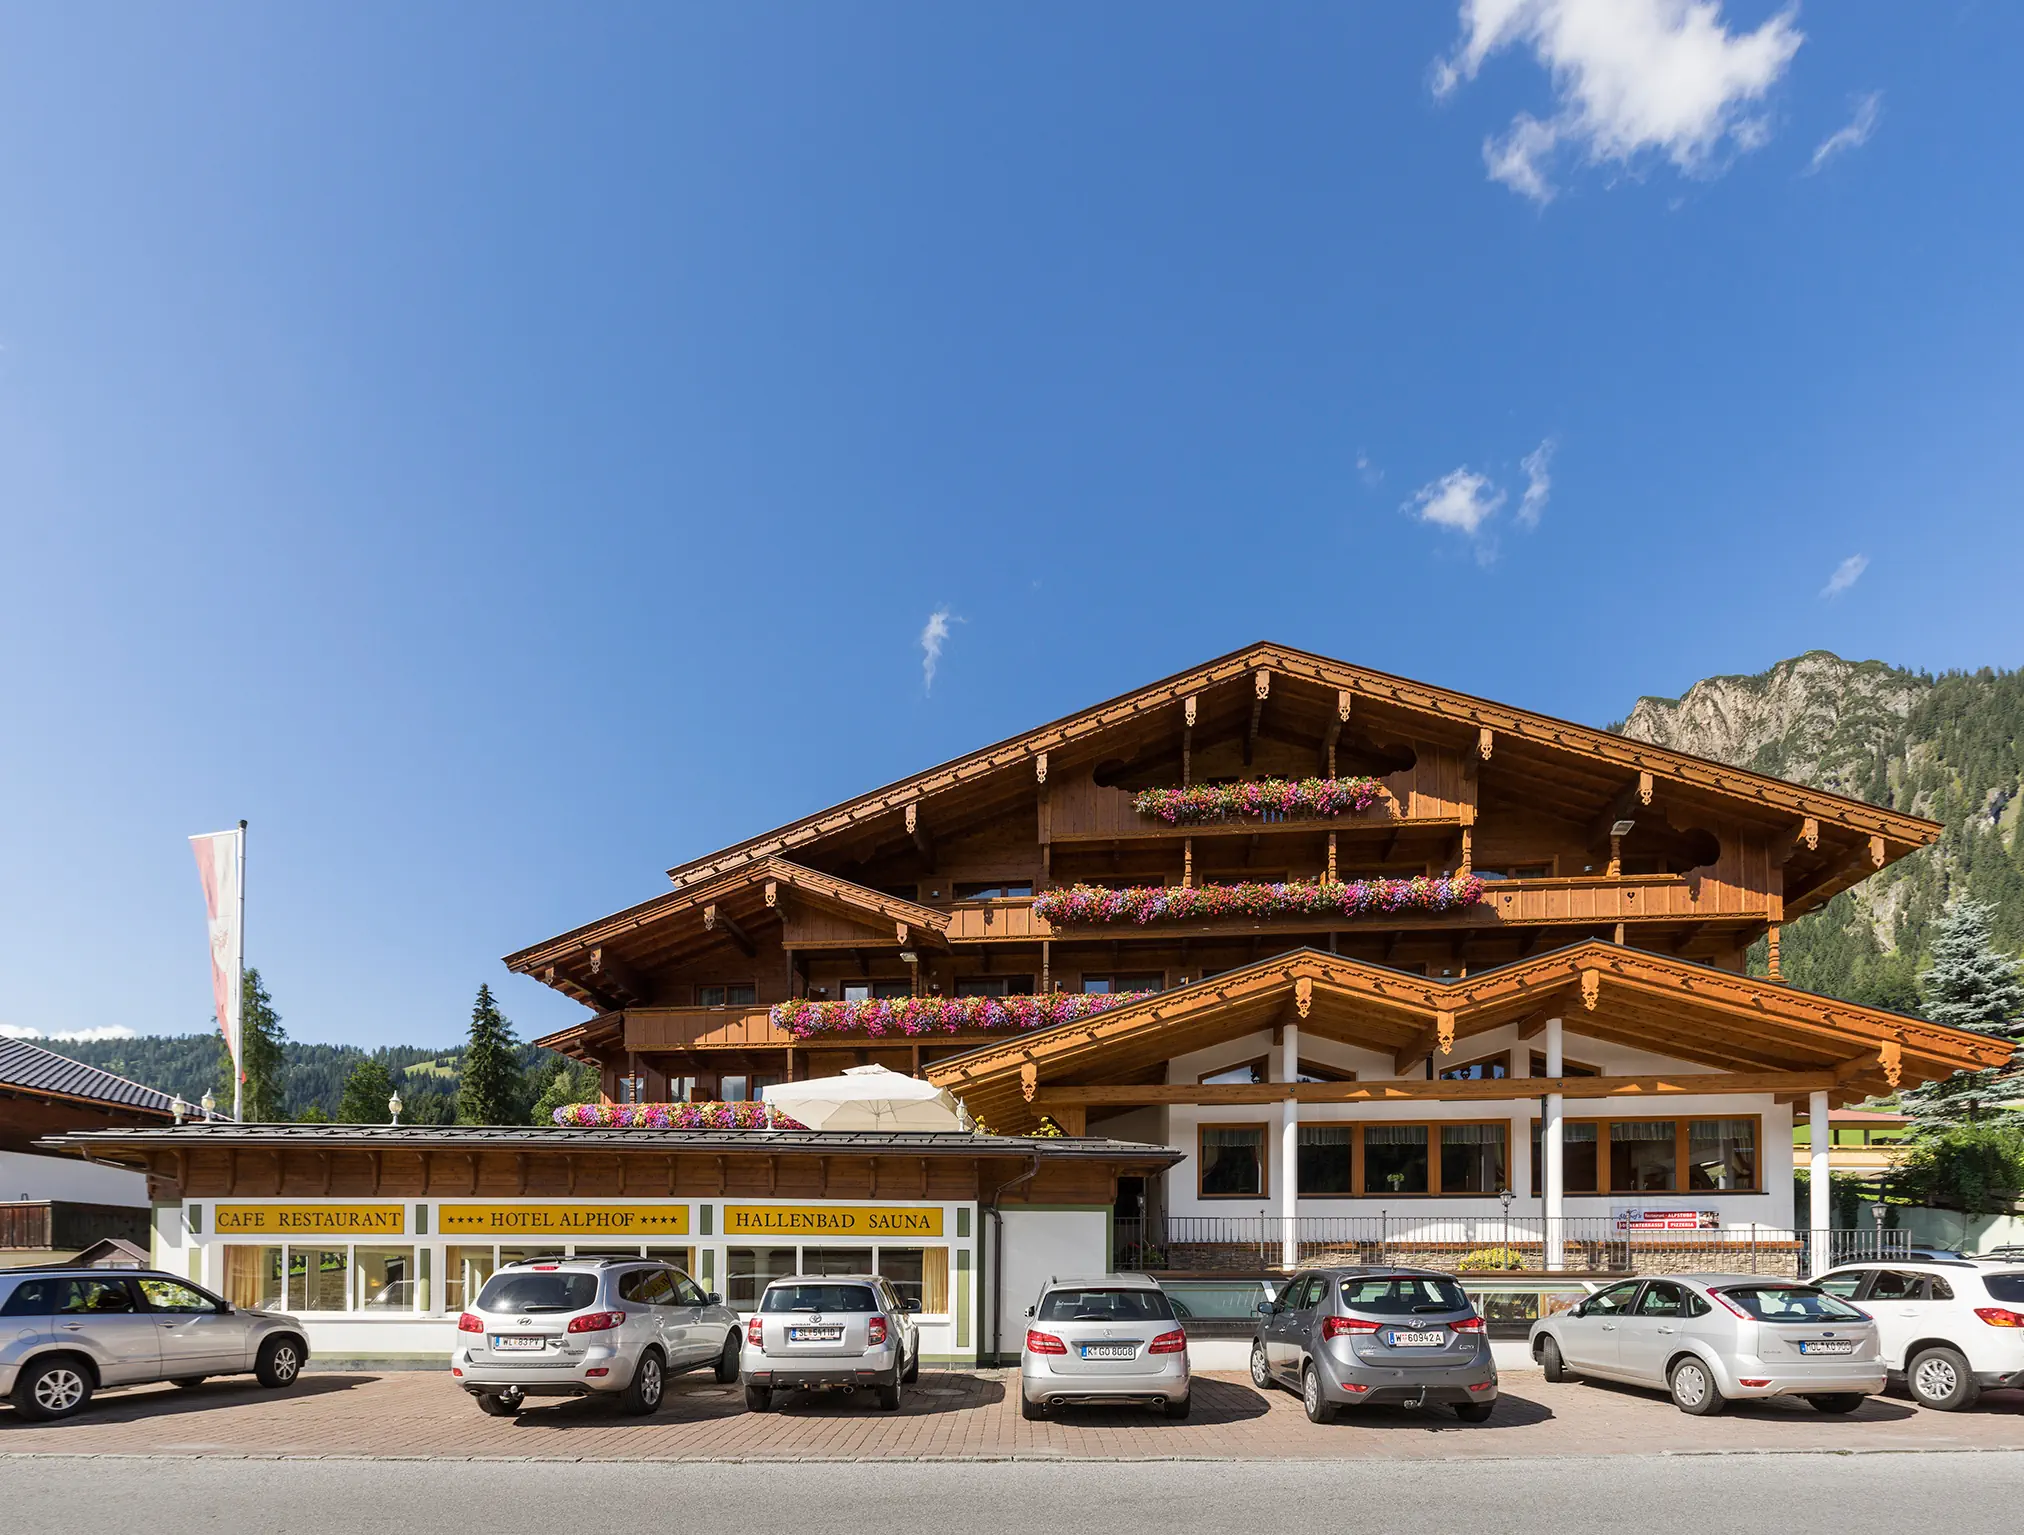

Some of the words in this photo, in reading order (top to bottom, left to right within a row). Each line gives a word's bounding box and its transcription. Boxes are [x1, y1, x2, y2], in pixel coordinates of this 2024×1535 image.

[218, 1212, 265, 1227] CAFE
[278, 1212, 402, 1227] RESTAURANT
[490, 1212, 555, 1227] HOTEL
[559, 1212, 635, 1227] ALPHOF
[735, 1212, 855, 1228] HALLENBAD
[868, 1214, 931, 1229] SAUNA
[799, 1328, 807, 1336] SL
[1395, 1333, 1402, 1342] W
[503, 1338, 512, 1347] WL
